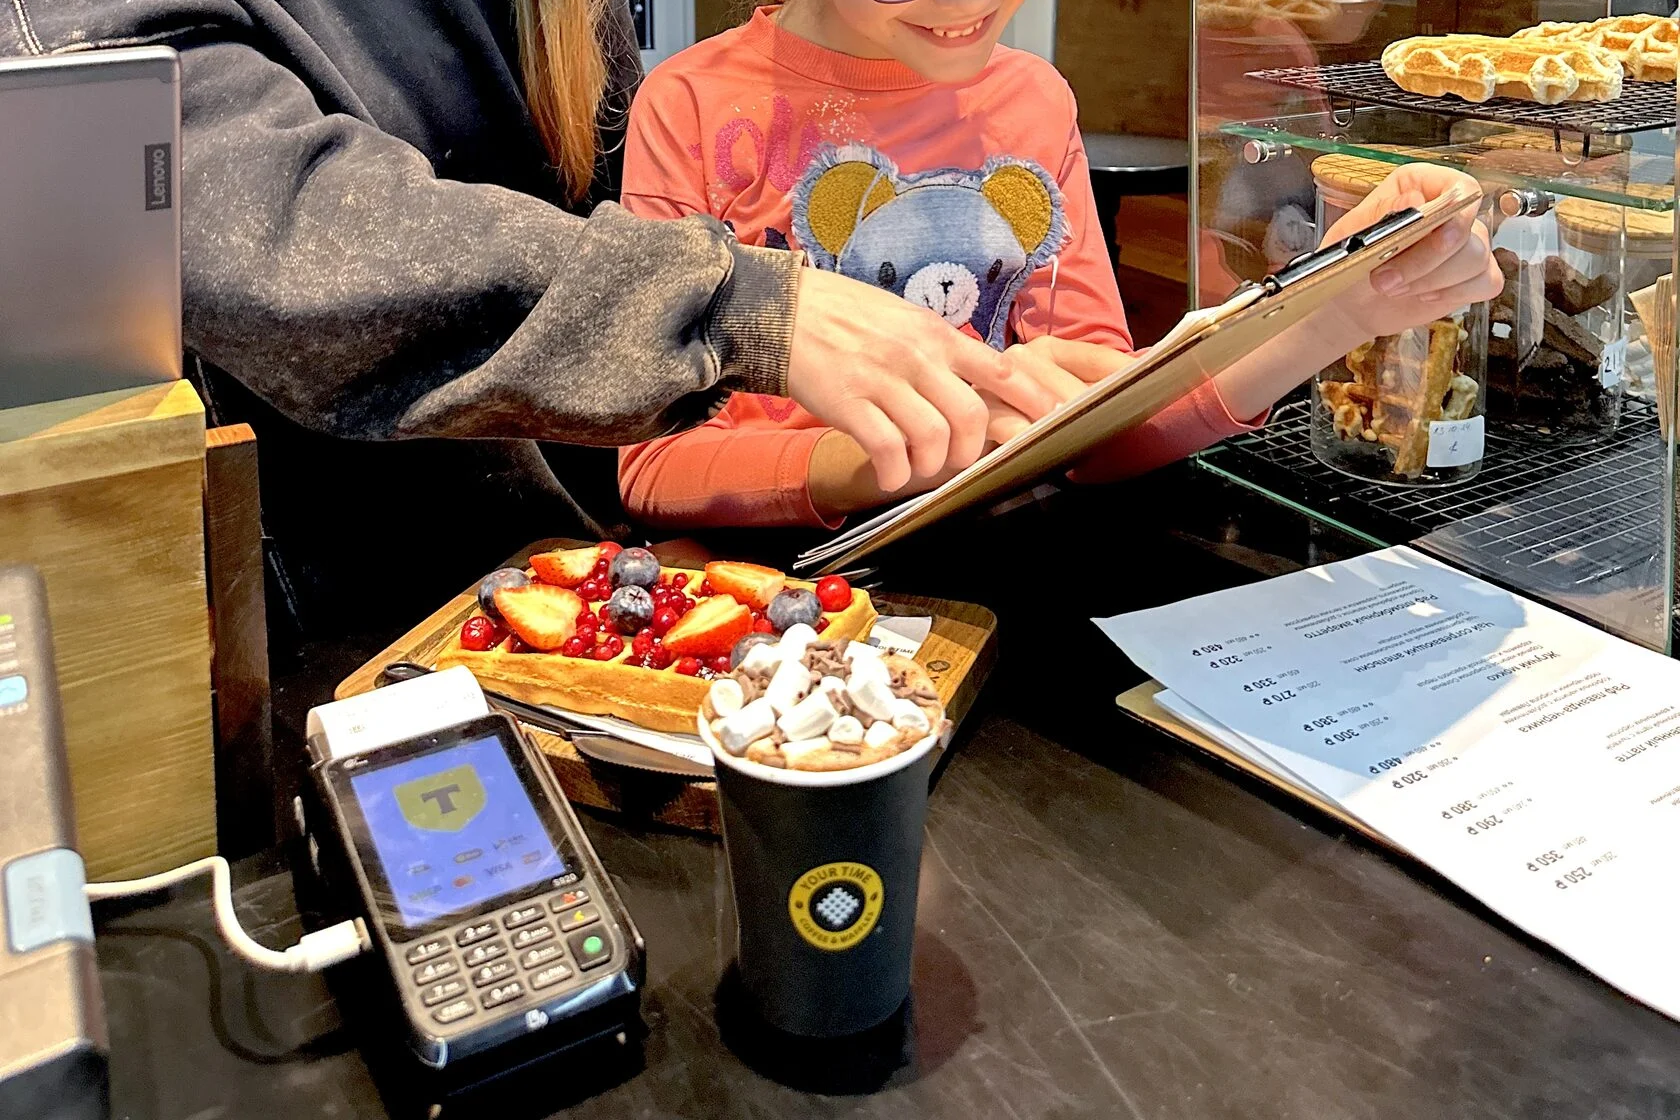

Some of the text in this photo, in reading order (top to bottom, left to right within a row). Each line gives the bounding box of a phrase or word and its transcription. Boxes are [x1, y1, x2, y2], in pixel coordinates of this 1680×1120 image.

[151, 149, 166, 205] Lenovo
[1353, 601, 1415, 624] пломбирный
[1304, 621, 1353, 638] амаретто
[1201, 644, 1223, 653] 480
[1354, 623, 1495, 672] Чай согревающий апельсин
[1219, 656, 1243, 665] 320
[1487, 651, 1560, 681] Жгучий мокко
[1252, 678, 1277, 688] 330
[1271, 690, 1296, 701] 270
[1519, 683, 1630, 732] Раф лаванда-черника
[1312, 716, 1338, 728] 380
[1333, 729, 1359, 741] 300
[1615, 727, 1680, 762] енный латте
[1378, 758, 1402, 769] 480
[1401, 771, 1428, 784] 320
[420, 784, 461, 815] T
[1450, 800, 1477, 814] 380
[1476, 815, 1503, 829] 290
[1535, 850, 1564, 866] 350
[484, 862, 513, 876] VISA
[1564, 867, 1592, 883] 250
[800, 866, 873, 890] YOUR TIME
[800, 918, 828, 943] COFFEE
